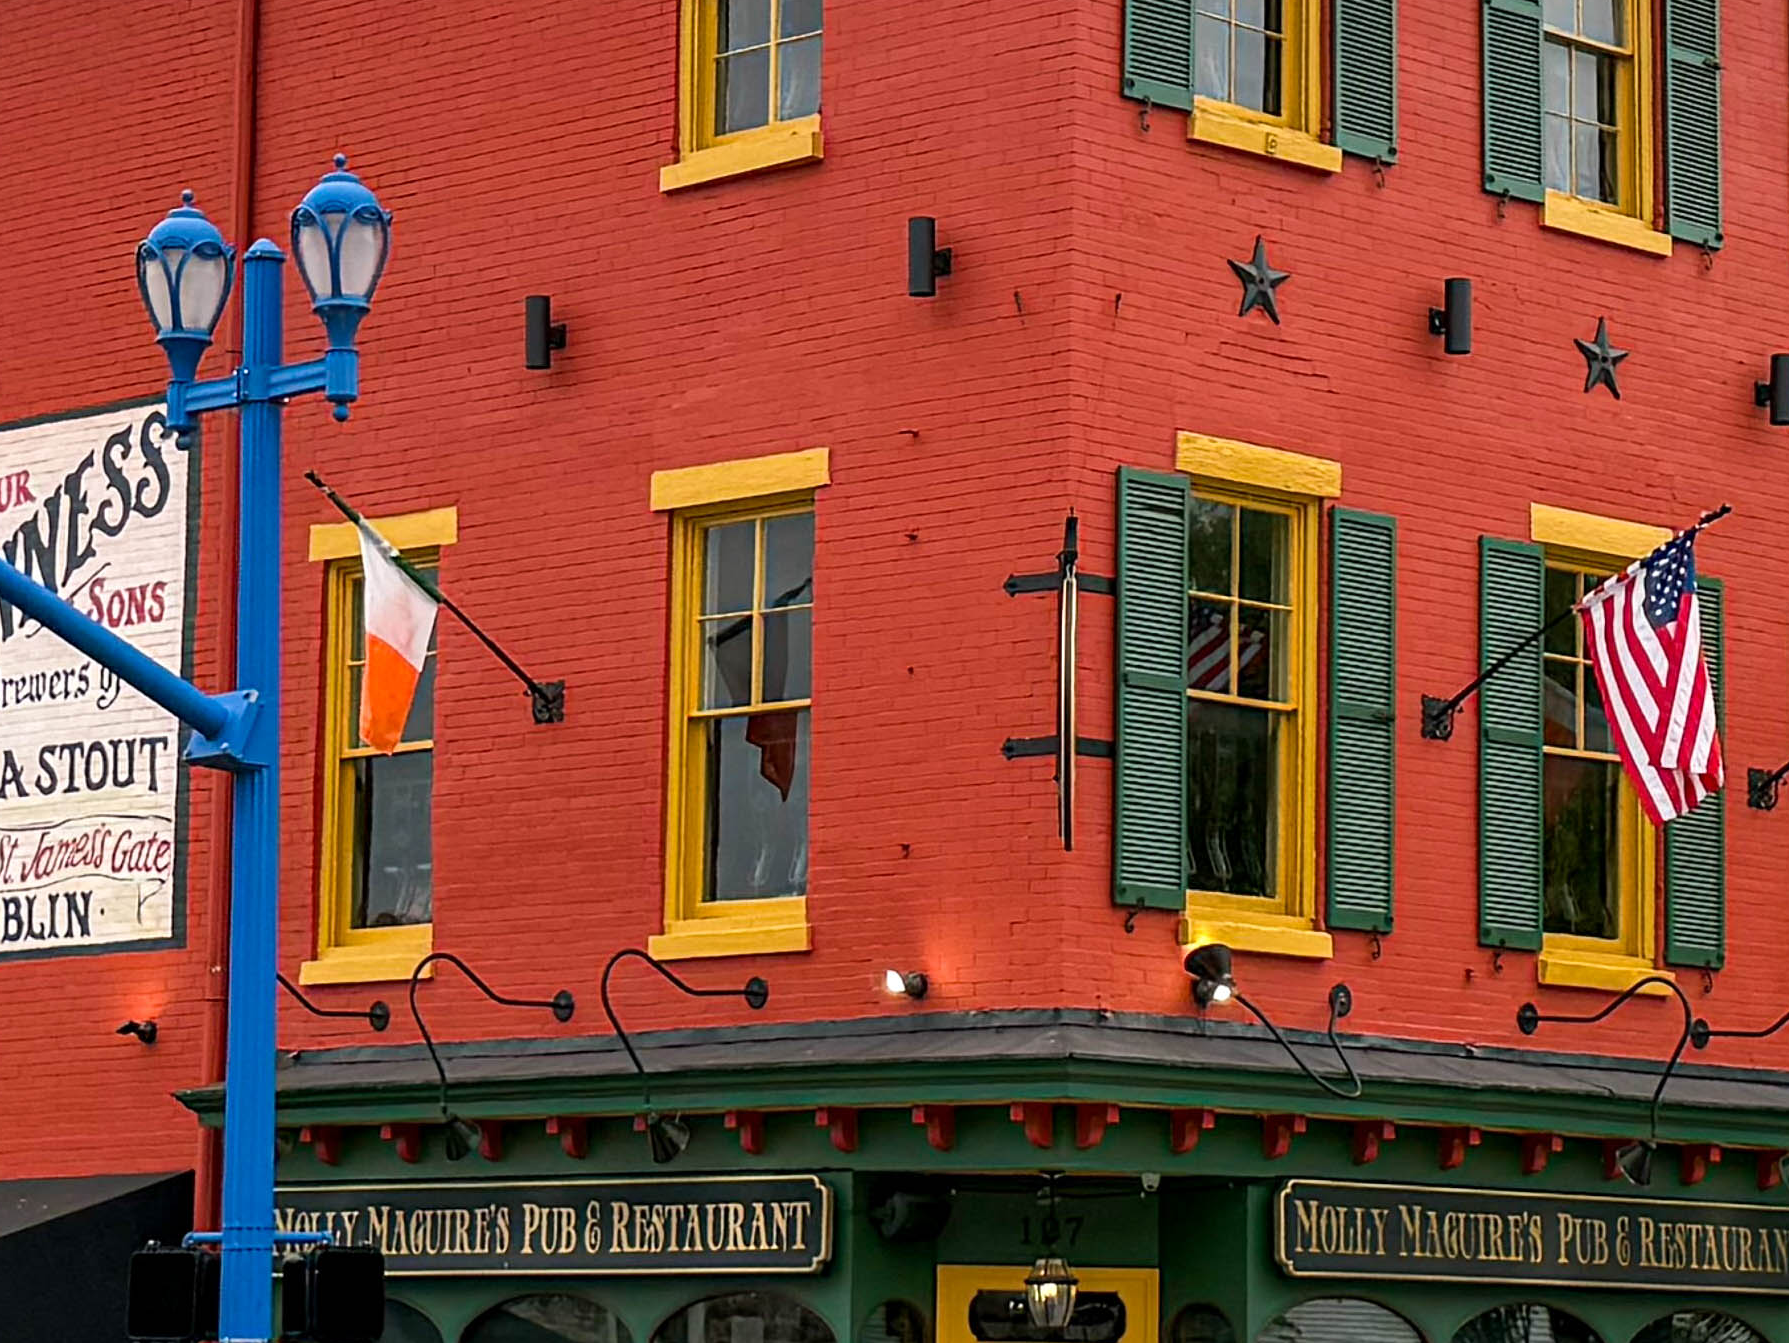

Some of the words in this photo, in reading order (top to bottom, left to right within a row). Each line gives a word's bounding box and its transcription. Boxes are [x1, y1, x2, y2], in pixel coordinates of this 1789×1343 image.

[35, 736, 168, 796] STOUT
[366, 1203, 511, 1256] MAGUIRE'S
[521, 1203, 578, 1256] PUB
[585, 1200, 601, 1252] &
[609, 1200, 812, 1255] RESTAURANT
[1293, 1199, 1389, 1255] MOLLY
[1398, 1204, 1543, 1263] MAGUIRE'S
[1556, 1212, 1609, 1265] PUB
[1616, 1215, 1631, 1266] &
